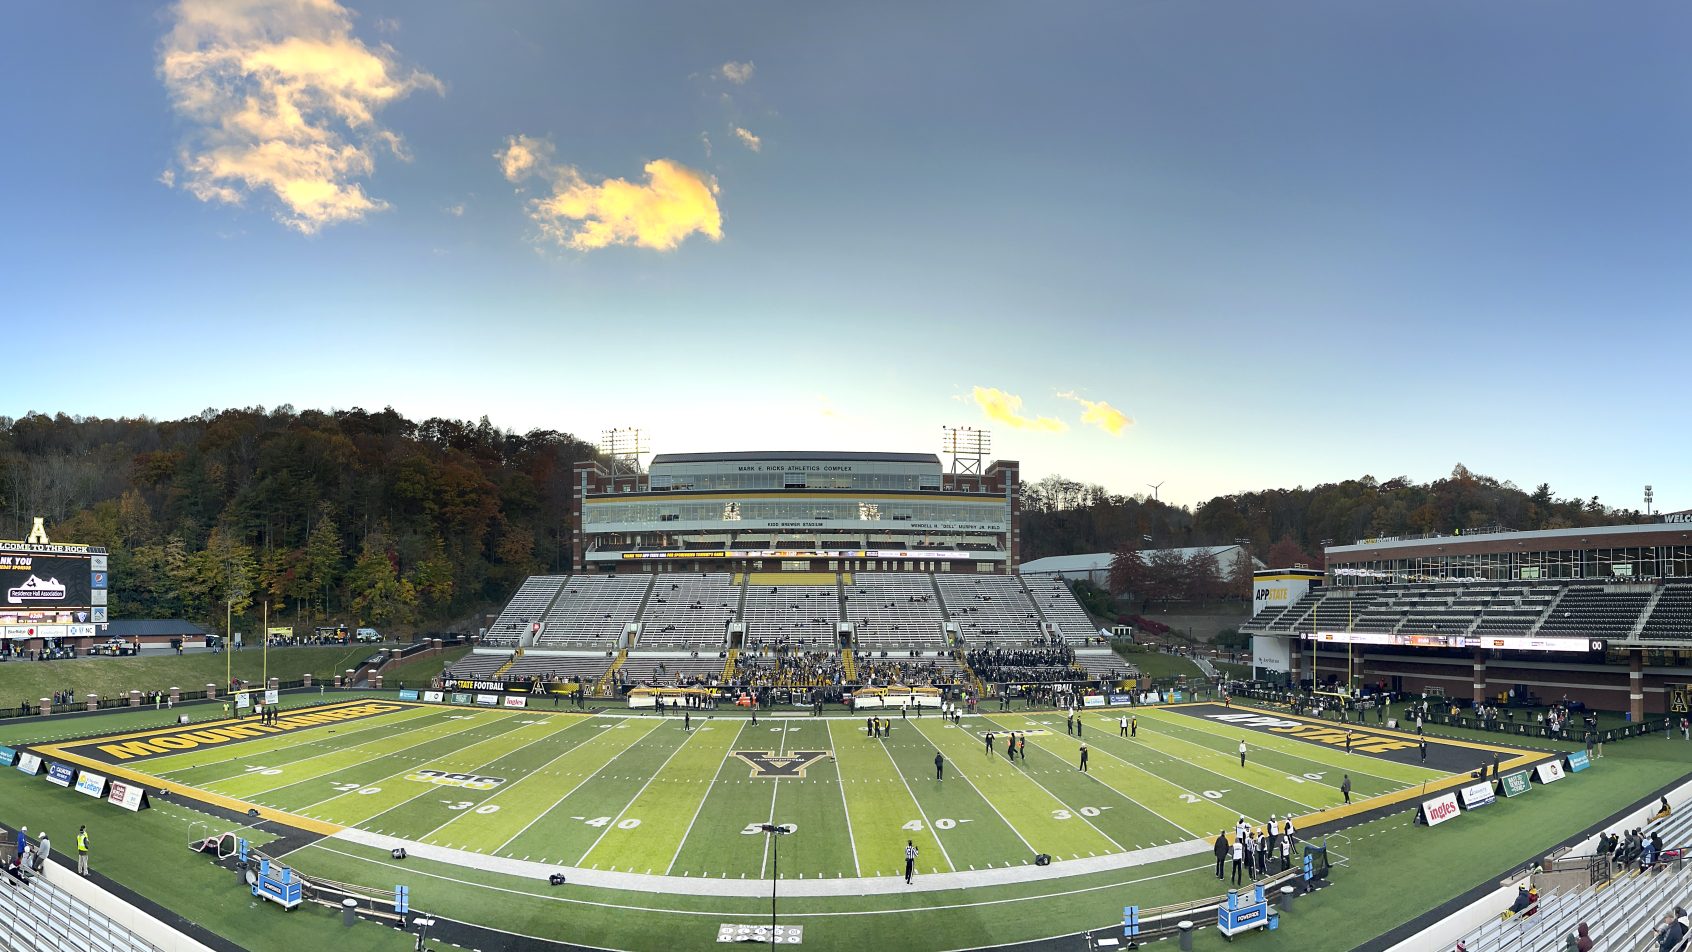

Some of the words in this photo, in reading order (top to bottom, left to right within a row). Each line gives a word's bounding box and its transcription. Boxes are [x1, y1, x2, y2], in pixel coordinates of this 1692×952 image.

[28, 516, 49, 544] A
[45, 544, 63, 552] THE
[0, 557, 15, 565] NK
[15, 557, 33, 565] YOU
[1255, 588, 1270, 601] APP
[1269, 588, 1288, 600] STATE
[1592, 641, 1602, 650] 00
[474, 681, 504, 690] FOOTBALL
[1671, 690, 1688, 712] A
[1179, 790, 1224, 804] 20
[448, 801, 500, 814] 30
[1051, 807, 1101, 820] 30
[1428, 801, 1456, 820] ingles
[584, 816, 642, 829] 40
[740, 823, 798, 835] 50
[901, 818, 957, 831] 40
